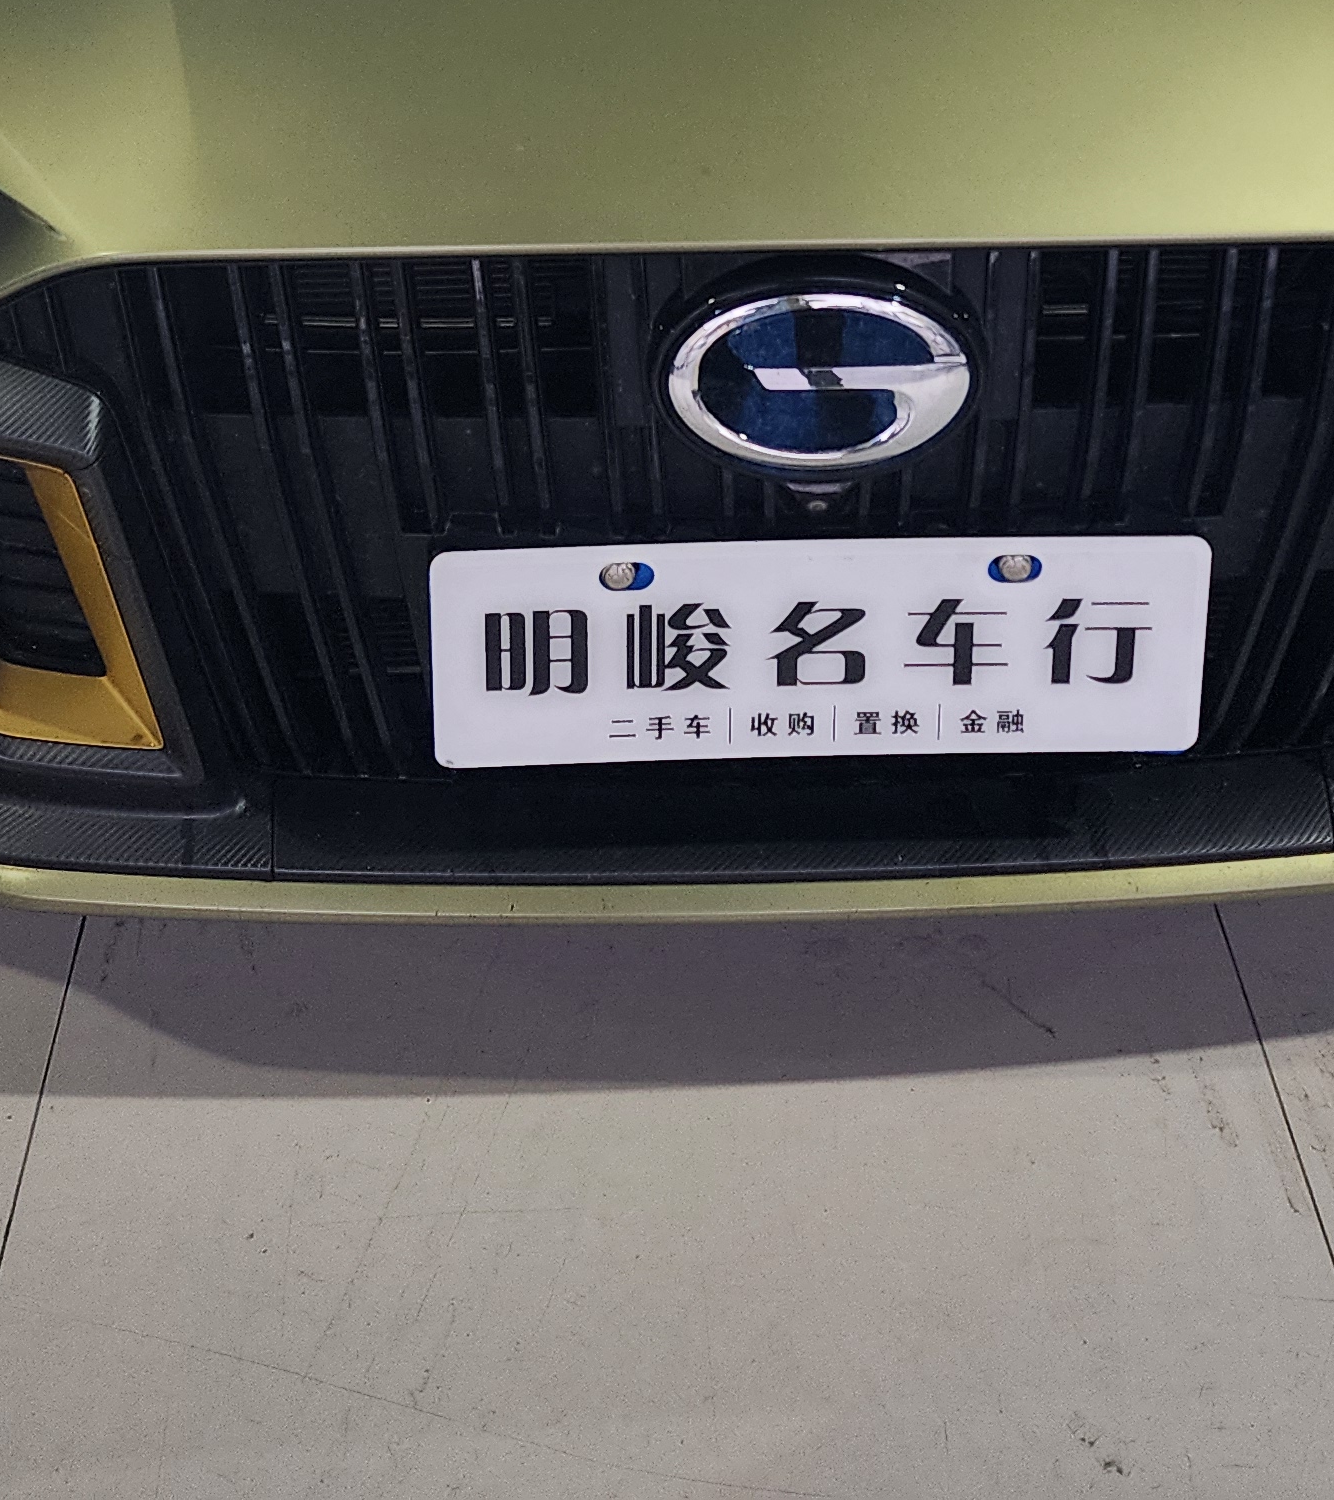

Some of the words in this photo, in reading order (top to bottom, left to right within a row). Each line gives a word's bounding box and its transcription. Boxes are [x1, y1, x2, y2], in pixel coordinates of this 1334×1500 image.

[484, 598, 1153, 697] 明峻名车行
[608, 713, 711, 742] 二手车
[749, 711, 816, 737] 收购
[853, 709, 921, 736] 置换
[959, 708, 1025, 734] 金融
